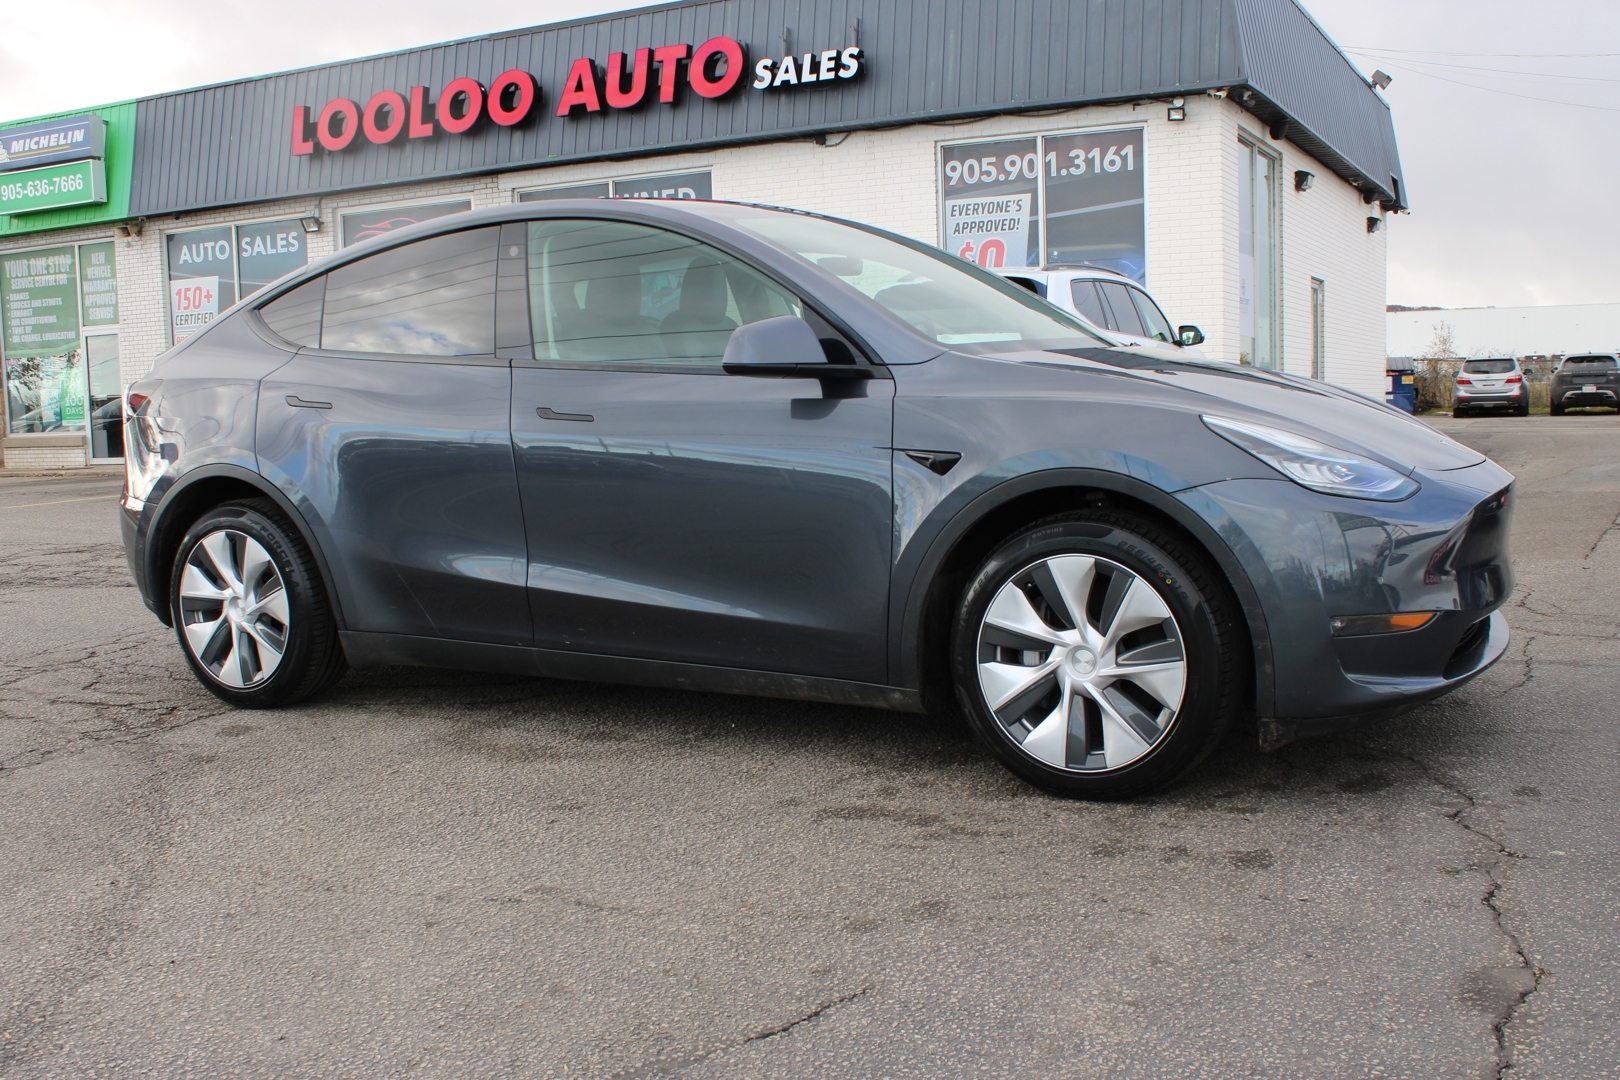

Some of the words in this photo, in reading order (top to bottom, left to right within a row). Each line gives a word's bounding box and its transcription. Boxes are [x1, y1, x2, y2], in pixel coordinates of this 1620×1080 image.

[291, 68, 534, 156] LOOLOO
[555, 36, 744, 118] AUTO
[753, 46, 860, 90] SALES
[10, 129, 85, 153] MICHELIN
[945, 144, 1134, 186] 905.901.3161
[1, 174, 83, 201] 905-636-7666
[950, 198, 1022, 217] EVERYONE'S
[953, 217, 1020, 235] APPROVED!
[179, 240, 230, 264] AUTO
[241, 231, 299, 257] SALES
[92, 252, 106, 264] NEW
[4, 260, 28, 278] YOUR
[30, 258, 48, 276] ONE
[48, 254, 72, 274] STOP
[86, 266, 112, 278] VEHICLE
[12, 278, 34, 290] SERVICE
[34, 276, 56, 286] CENTRE
[56, 274, 68, 284] FOR
[82, 278, 116, 292] WARRANTY
[10, 292, 30, 300] BRAKES
[10, 300, 30, 308] SHOCKS
[42, 298, 62, 306] STRUTS
[86, 292, 116, 306] APPROVED
[175, 286, 213, 311] 150+
[10, 308, 32, 318] EXHAUST
[88, 306, 114, 320] SERVICE
[175, 312, 214, 326] CERTIFIED
[12, 318, 20, 326] AIR
[20, 316, 56, 324] CONDITIONING
[12, 326, 24, 334] TUNE
[12, 334, 20, 342] OIL
[42, 332, 76, 340] LUBRICATION
[64, 378, 80, 388] PAY
[66, 396, 84, 406] 100
[66, 408, 84, 416] DAYS
[1031, 527, 1064, 539] OUTSIDE
